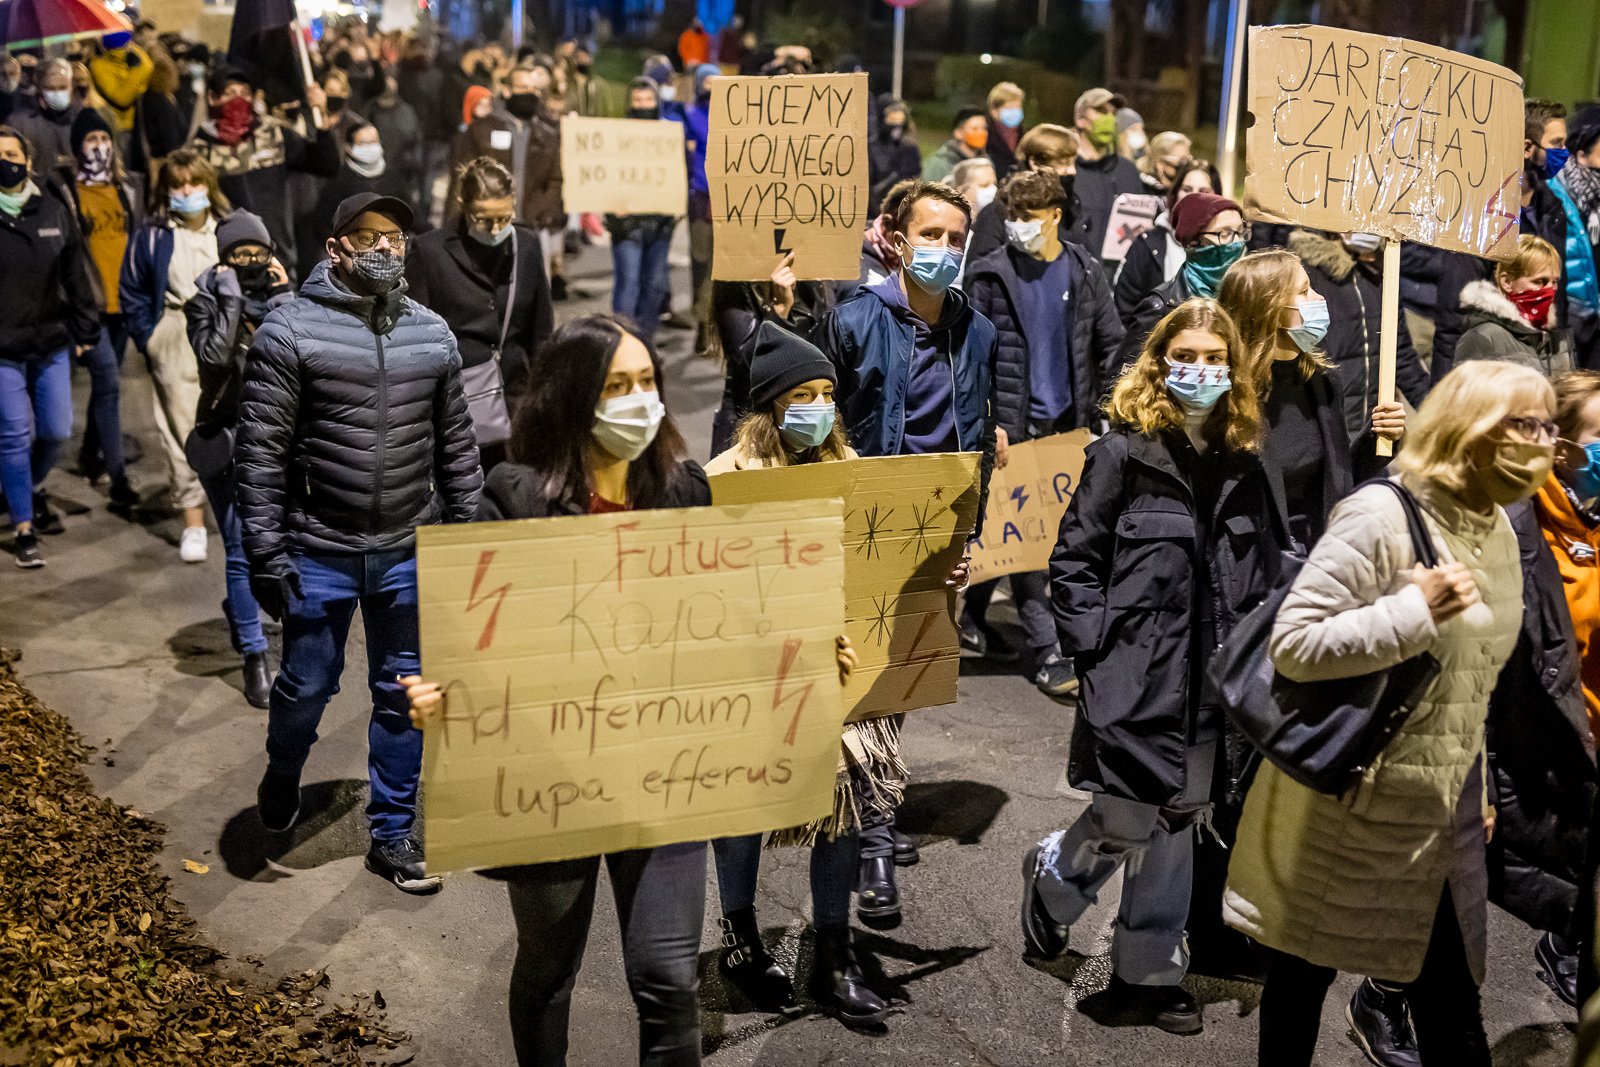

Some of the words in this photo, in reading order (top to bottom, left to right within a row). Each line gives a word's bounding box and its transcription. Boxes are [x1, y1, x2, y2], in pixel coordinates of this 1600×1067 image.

[727, 83, 853, 128] CHCEMY
[1277, 36, 1493, 125] JARECZKU
[575, 131, 603, 154] NO
[725, 133, 855, 180] WOLNEGO
[1273, 97, 1488, 188] CZMYCHAJ
[579, 165, 607, 187] NO
[725, 182, 857, 229] WYBORU
[614, 521, 754, 593] Futue
[776, 528, 825, 569] te
[440, 675, 512, 750] Ad
[550, 674, 753, 756] infernum
[494, 766, 614, 828] lupa
[642, 745, 793, 809] efferus
